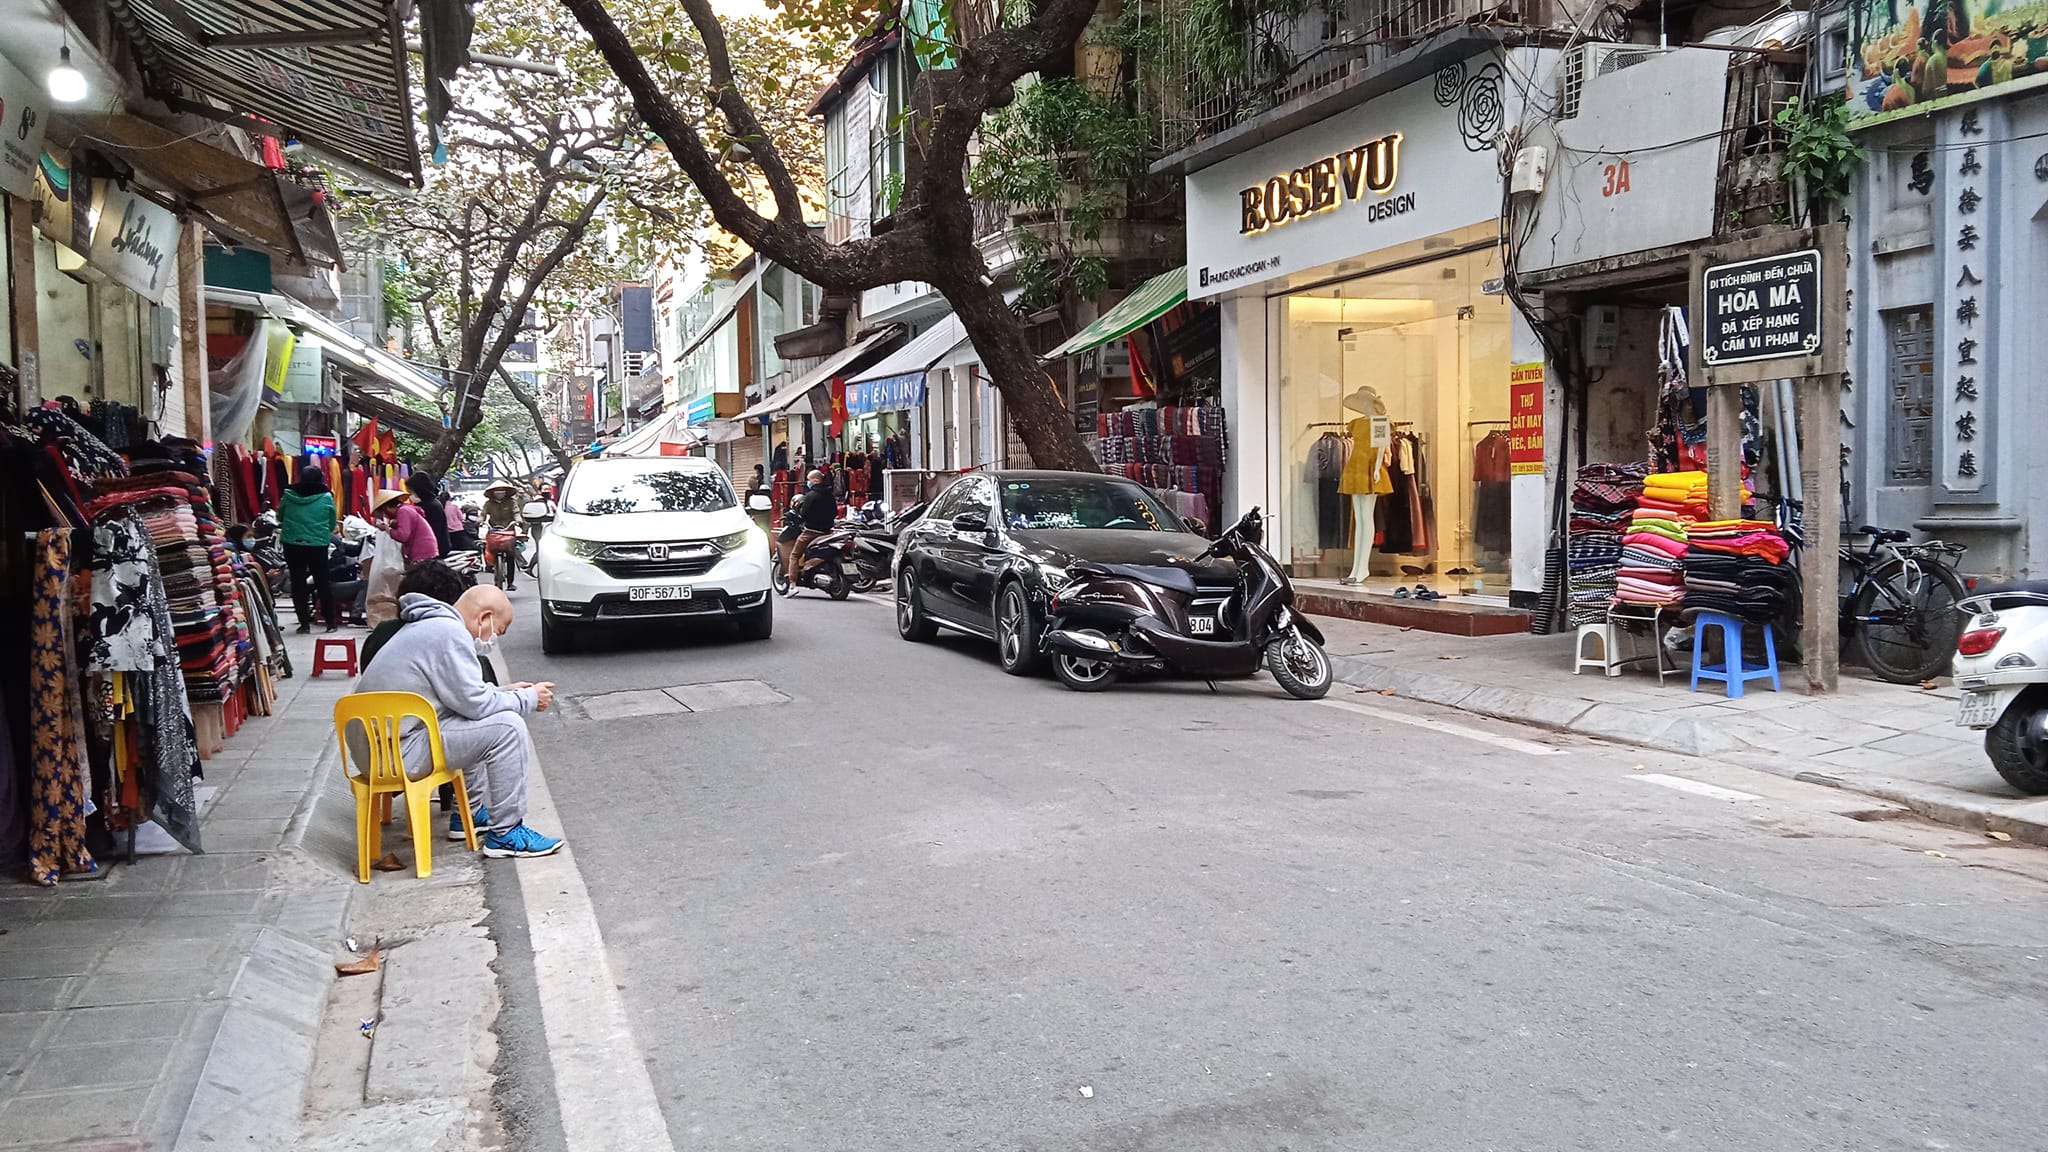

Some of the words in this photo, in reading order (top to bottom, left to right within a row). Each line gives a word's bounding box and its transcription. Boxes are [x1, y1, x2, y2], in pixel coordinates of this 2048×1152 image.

[1602, 160, 1630, 197] 3A
[1368, 192, 1415, 222] DESIGN
[1270, 256, 1281, 268] HN
[1710, 278, 1719, 290] DI
[1719, 273, 1740, 288] TÍCH
[1787, 260, 1813, 276] CHÙA
[1718, 287, 1760, 315] HÒA
[1769, 278, 1801, 307] MÃ
[1741, 313, 1763, 331] XẾP
[1765, 312, 1800, 328] HẠNG
[1721, 334, 1745, 351] CẤM
[1749, 336, 1761, 348] VI
[1765, 331, 1799, 346] PHẠM
[1520, 393, 1534, 410] THỢ
[1526, 414, 1542, 428] MAY
